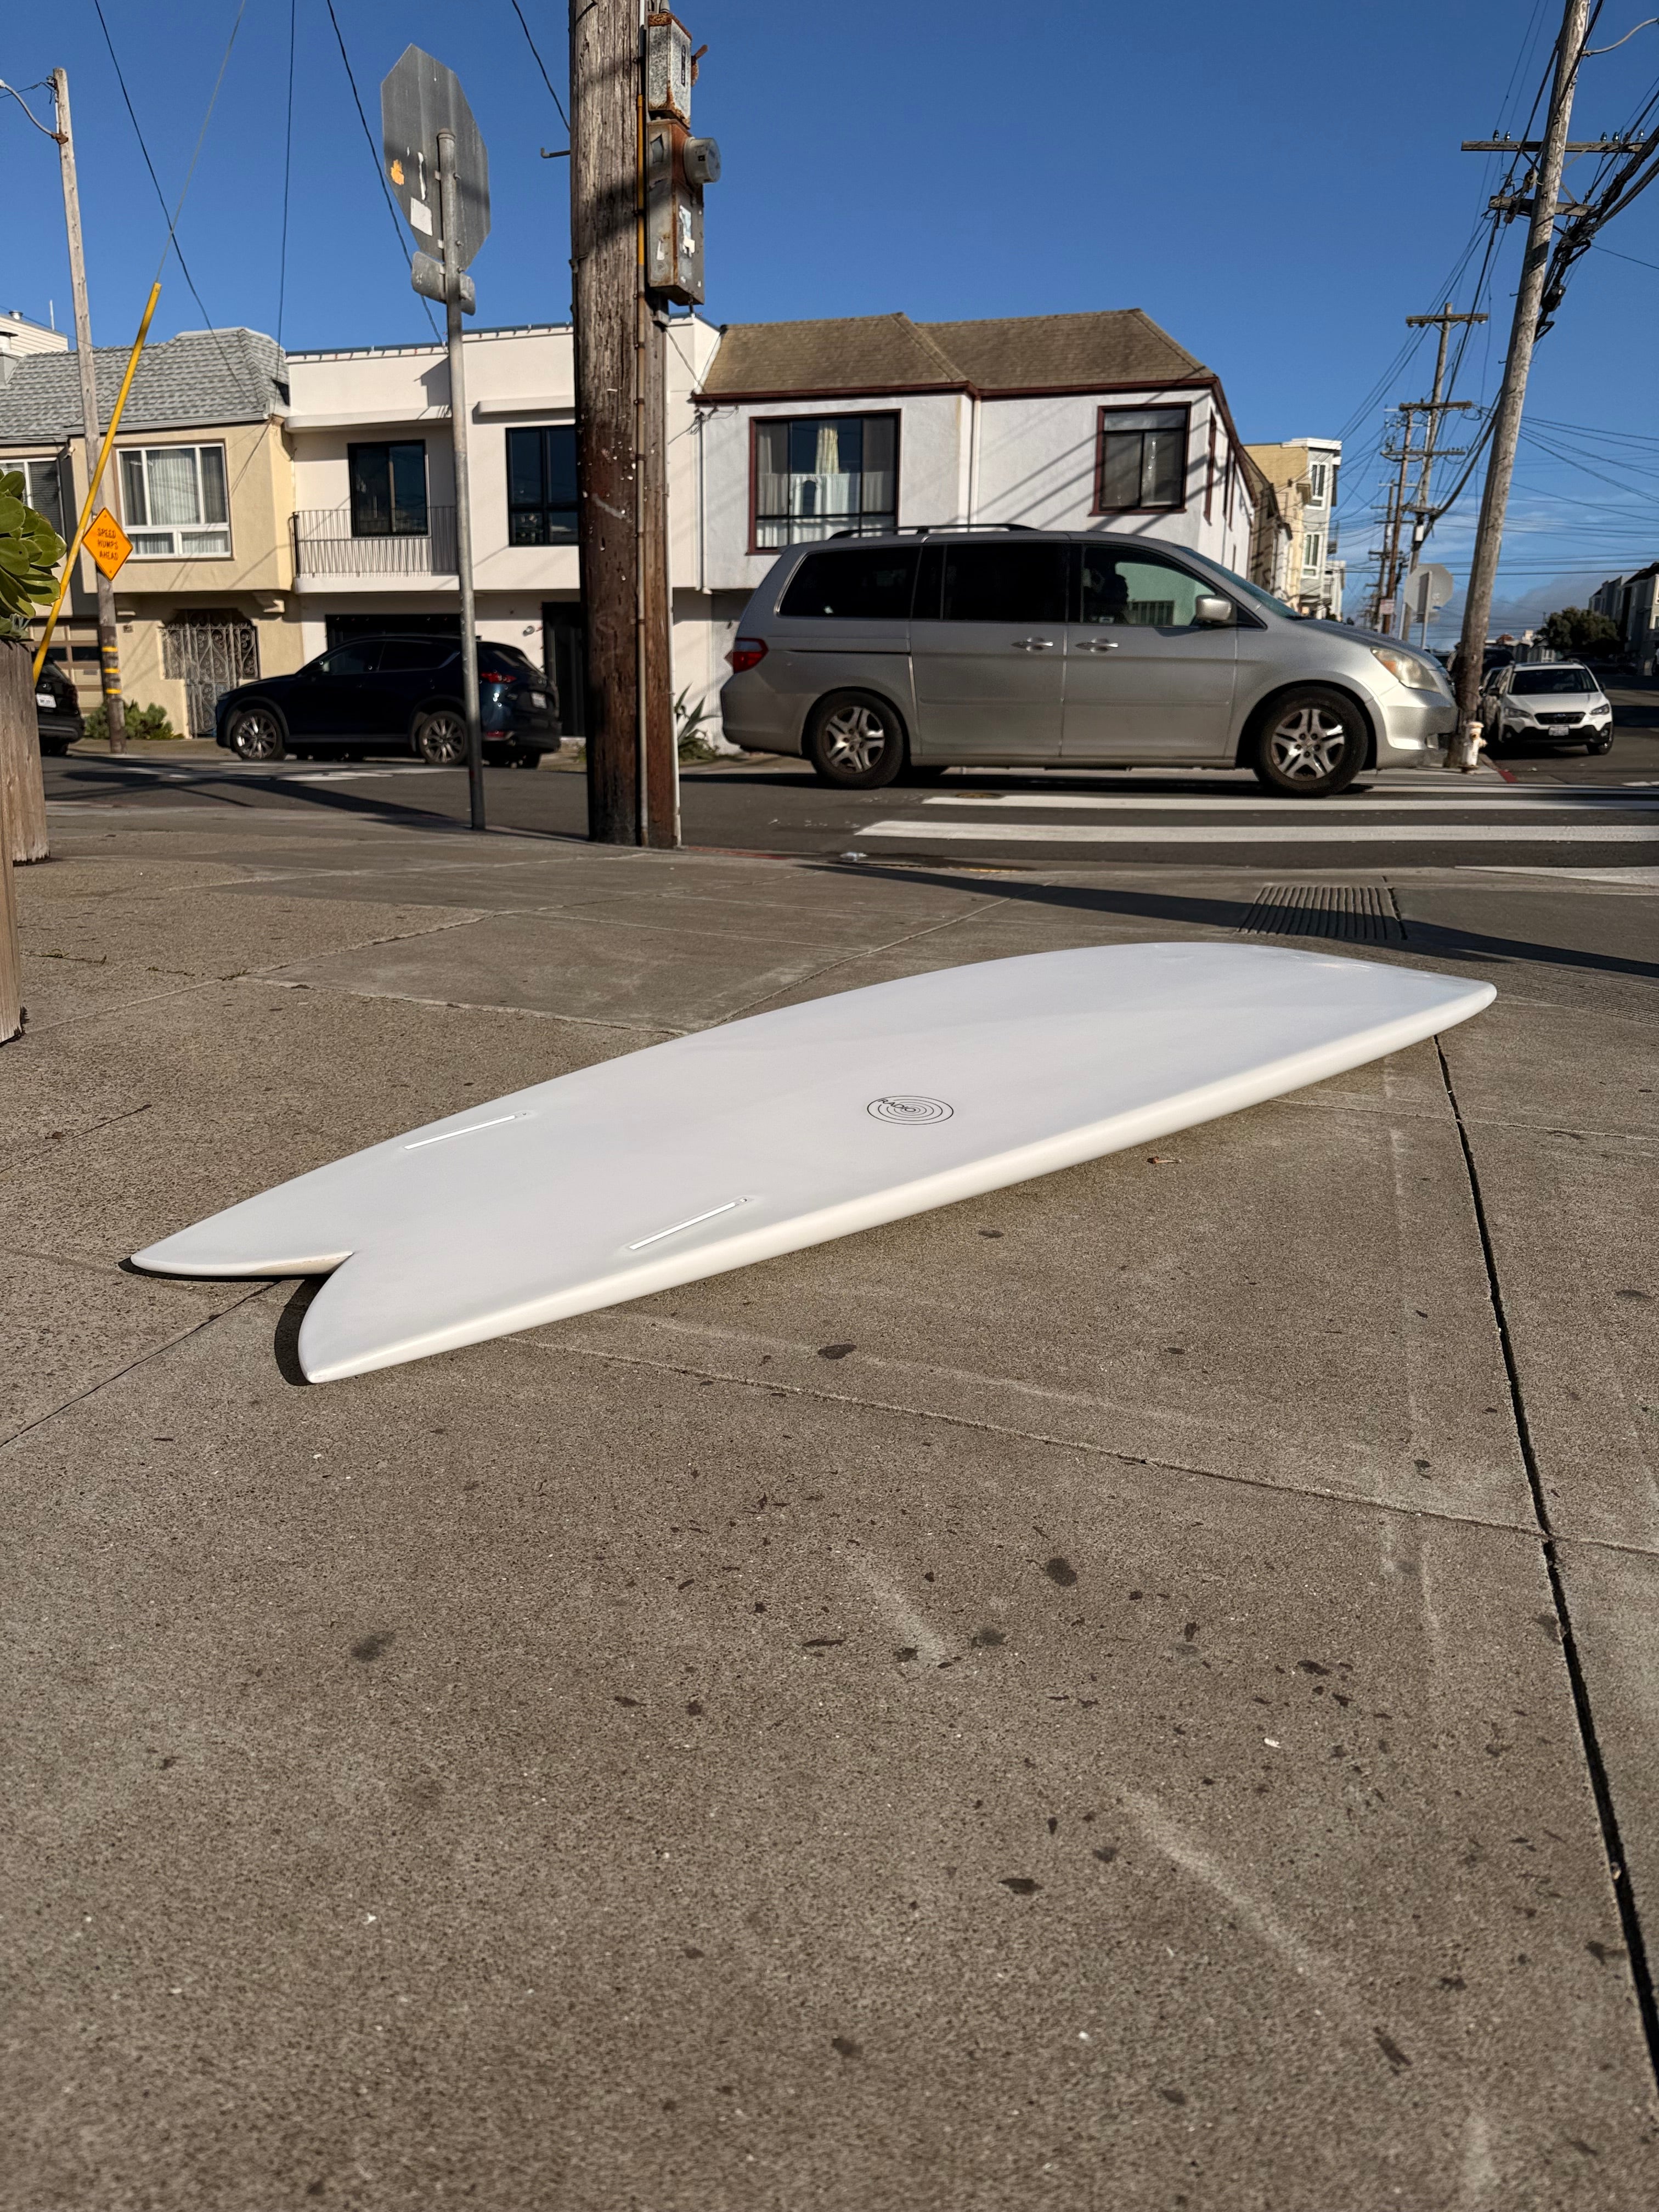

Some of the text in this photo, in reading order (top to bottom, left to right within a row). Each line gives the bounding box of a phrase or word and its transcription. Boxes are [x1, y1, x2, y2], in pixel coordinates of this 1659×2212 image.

[97, 528, 116, 538] SPEED
[98, 539, 119, 550] HUMPS
[99, 550, 119, 560] AHEAD
[878, 1099, 916, 1112] RADIO
